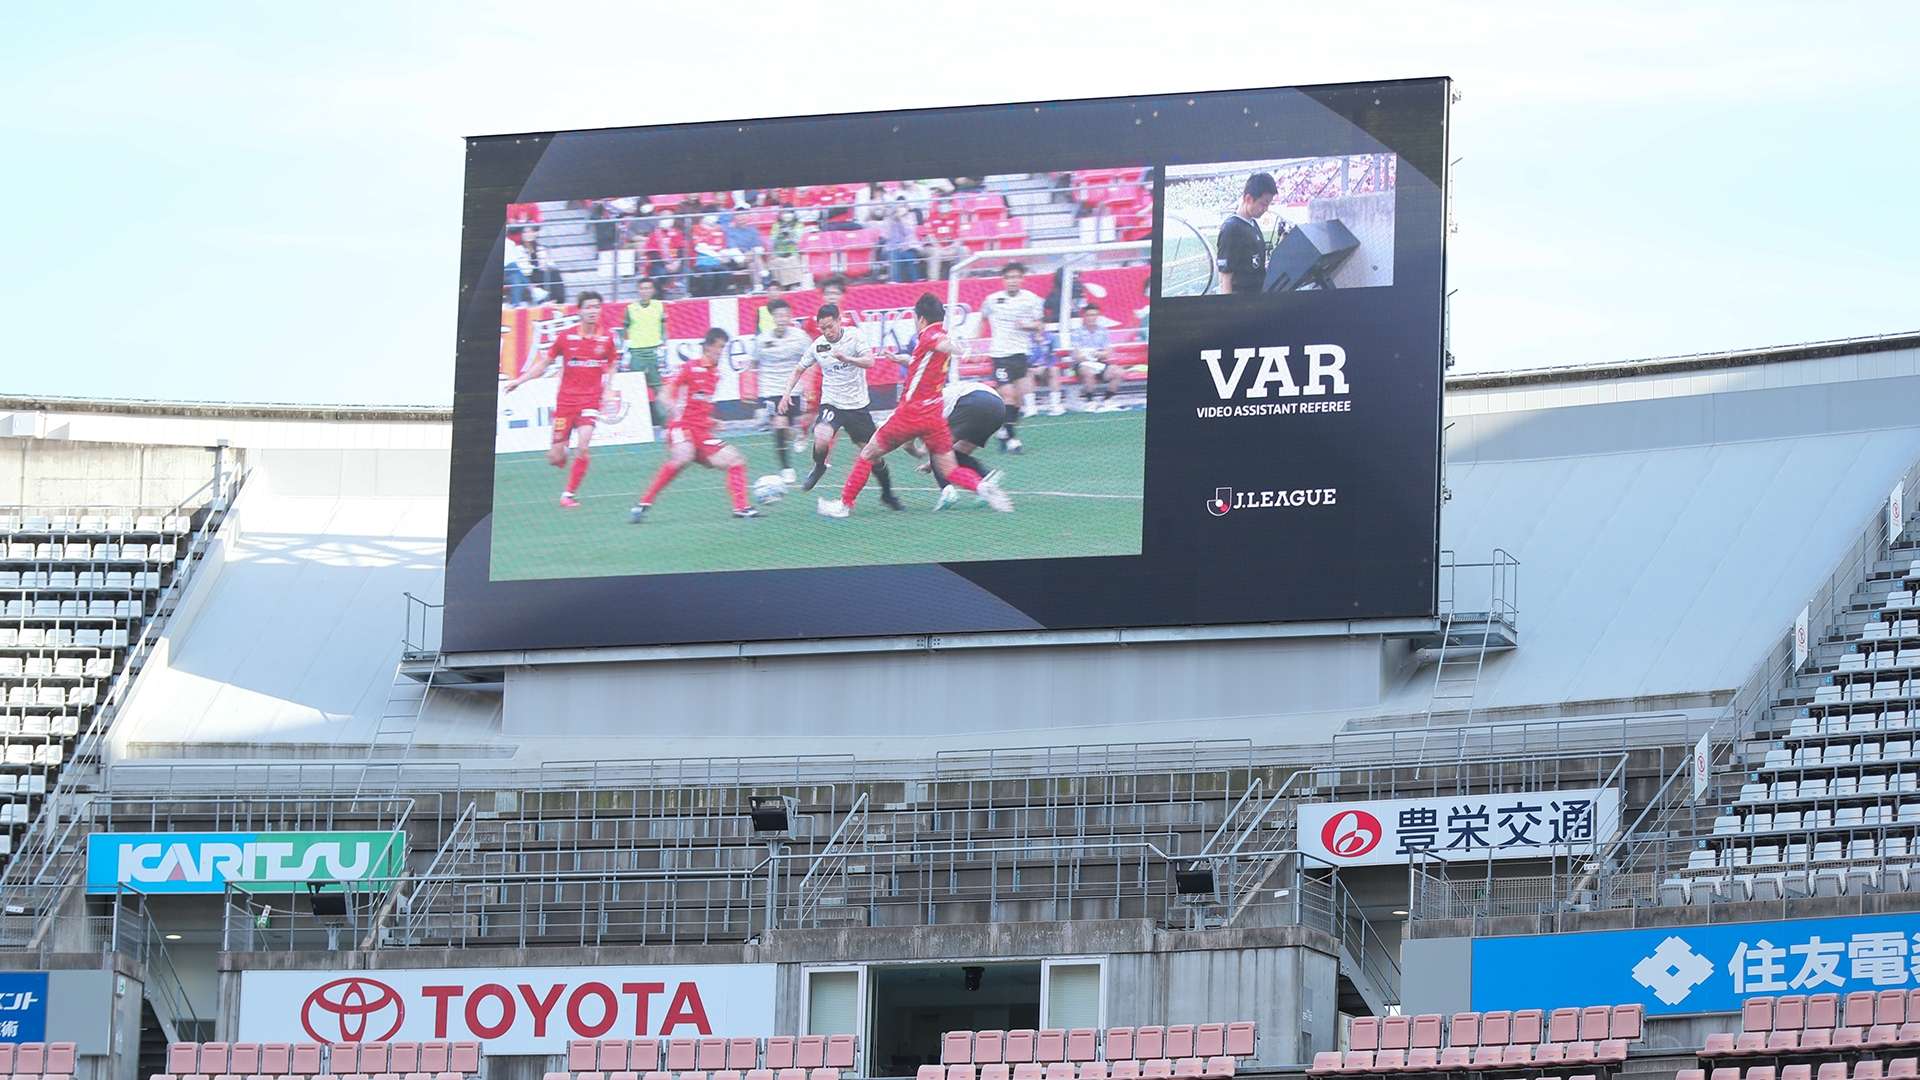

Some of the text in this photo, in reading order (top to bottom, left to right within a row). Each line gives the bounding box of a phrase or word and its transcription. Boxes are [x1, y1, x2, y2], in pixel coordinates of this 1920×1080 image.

[1200, 344, 1350, 399] VAR
[1196, 401, 1352, 418] VIDEO ASSISTANT REFEREE
[1233, 488, 1337, 509] J.LEAGUE
[1395, 799, 1593, 856] 豊栄交通
[1727, 931, 1920, 994] 住友電
[421, 981, 713, 1039] TOYOTA
